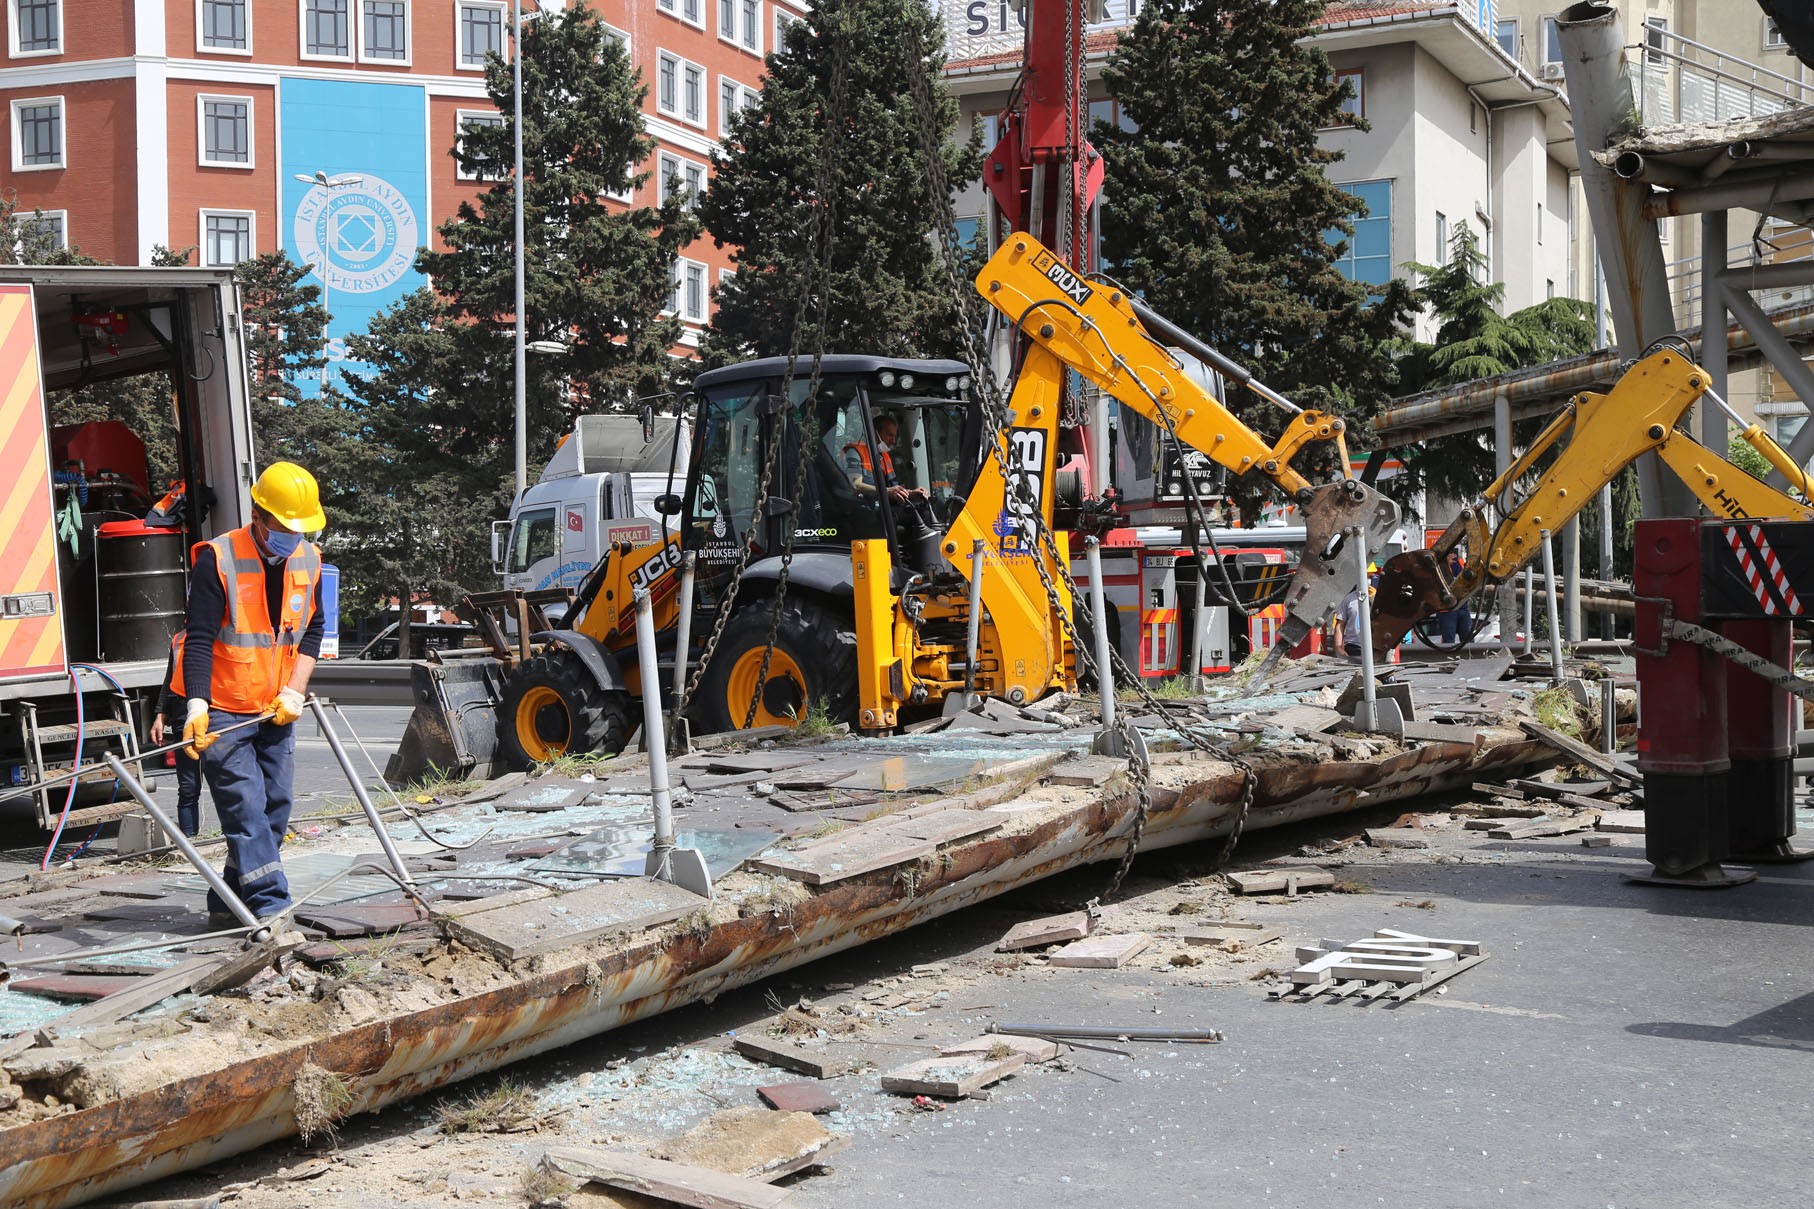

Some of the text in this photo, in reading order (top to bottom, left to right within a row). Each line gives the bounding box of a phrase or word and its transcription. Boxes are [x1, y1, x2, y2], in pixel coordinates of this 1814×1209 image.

[373, 184, 412, 226] AYDIN
[1048, 264, 1089, 302] 3CX
[1007, 430, 1044, 549] JCB
[633, 544, 682, 589] JCB
[699, 546, 743, 560] BÜYÜKŞEHİ
